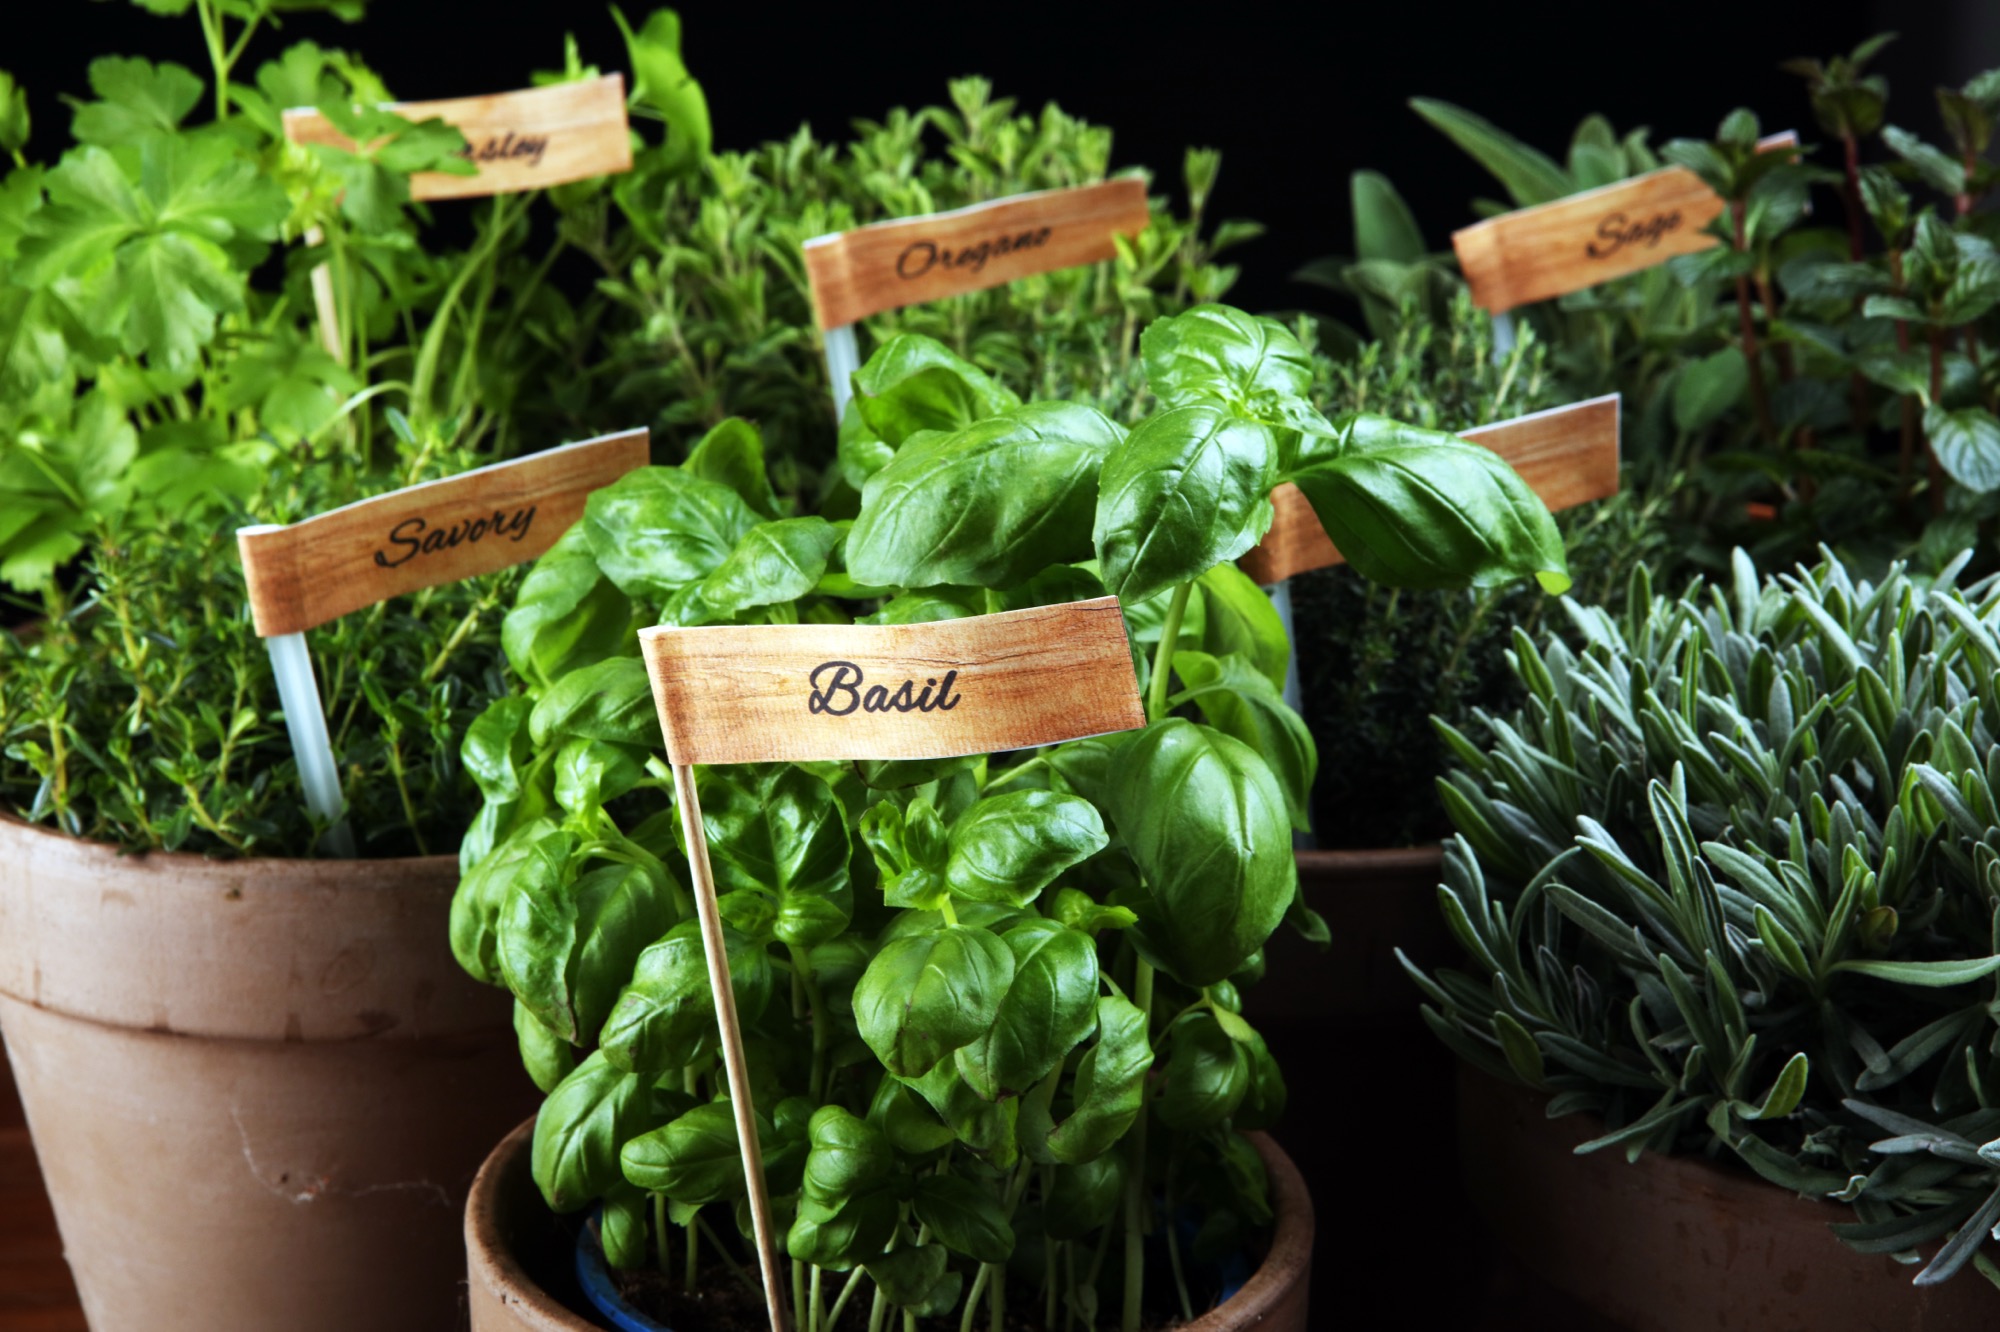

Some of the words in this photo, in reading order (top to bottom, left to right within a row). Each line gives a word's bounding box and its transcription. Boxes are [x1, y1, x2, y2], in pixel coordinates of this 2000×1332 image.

[896, 226, 1052, 280] Oregano
[1586, 210, 1682, 259] Sage
[374, 505, 537, 568] Savory
[808, 660, 962, 716] Basil
